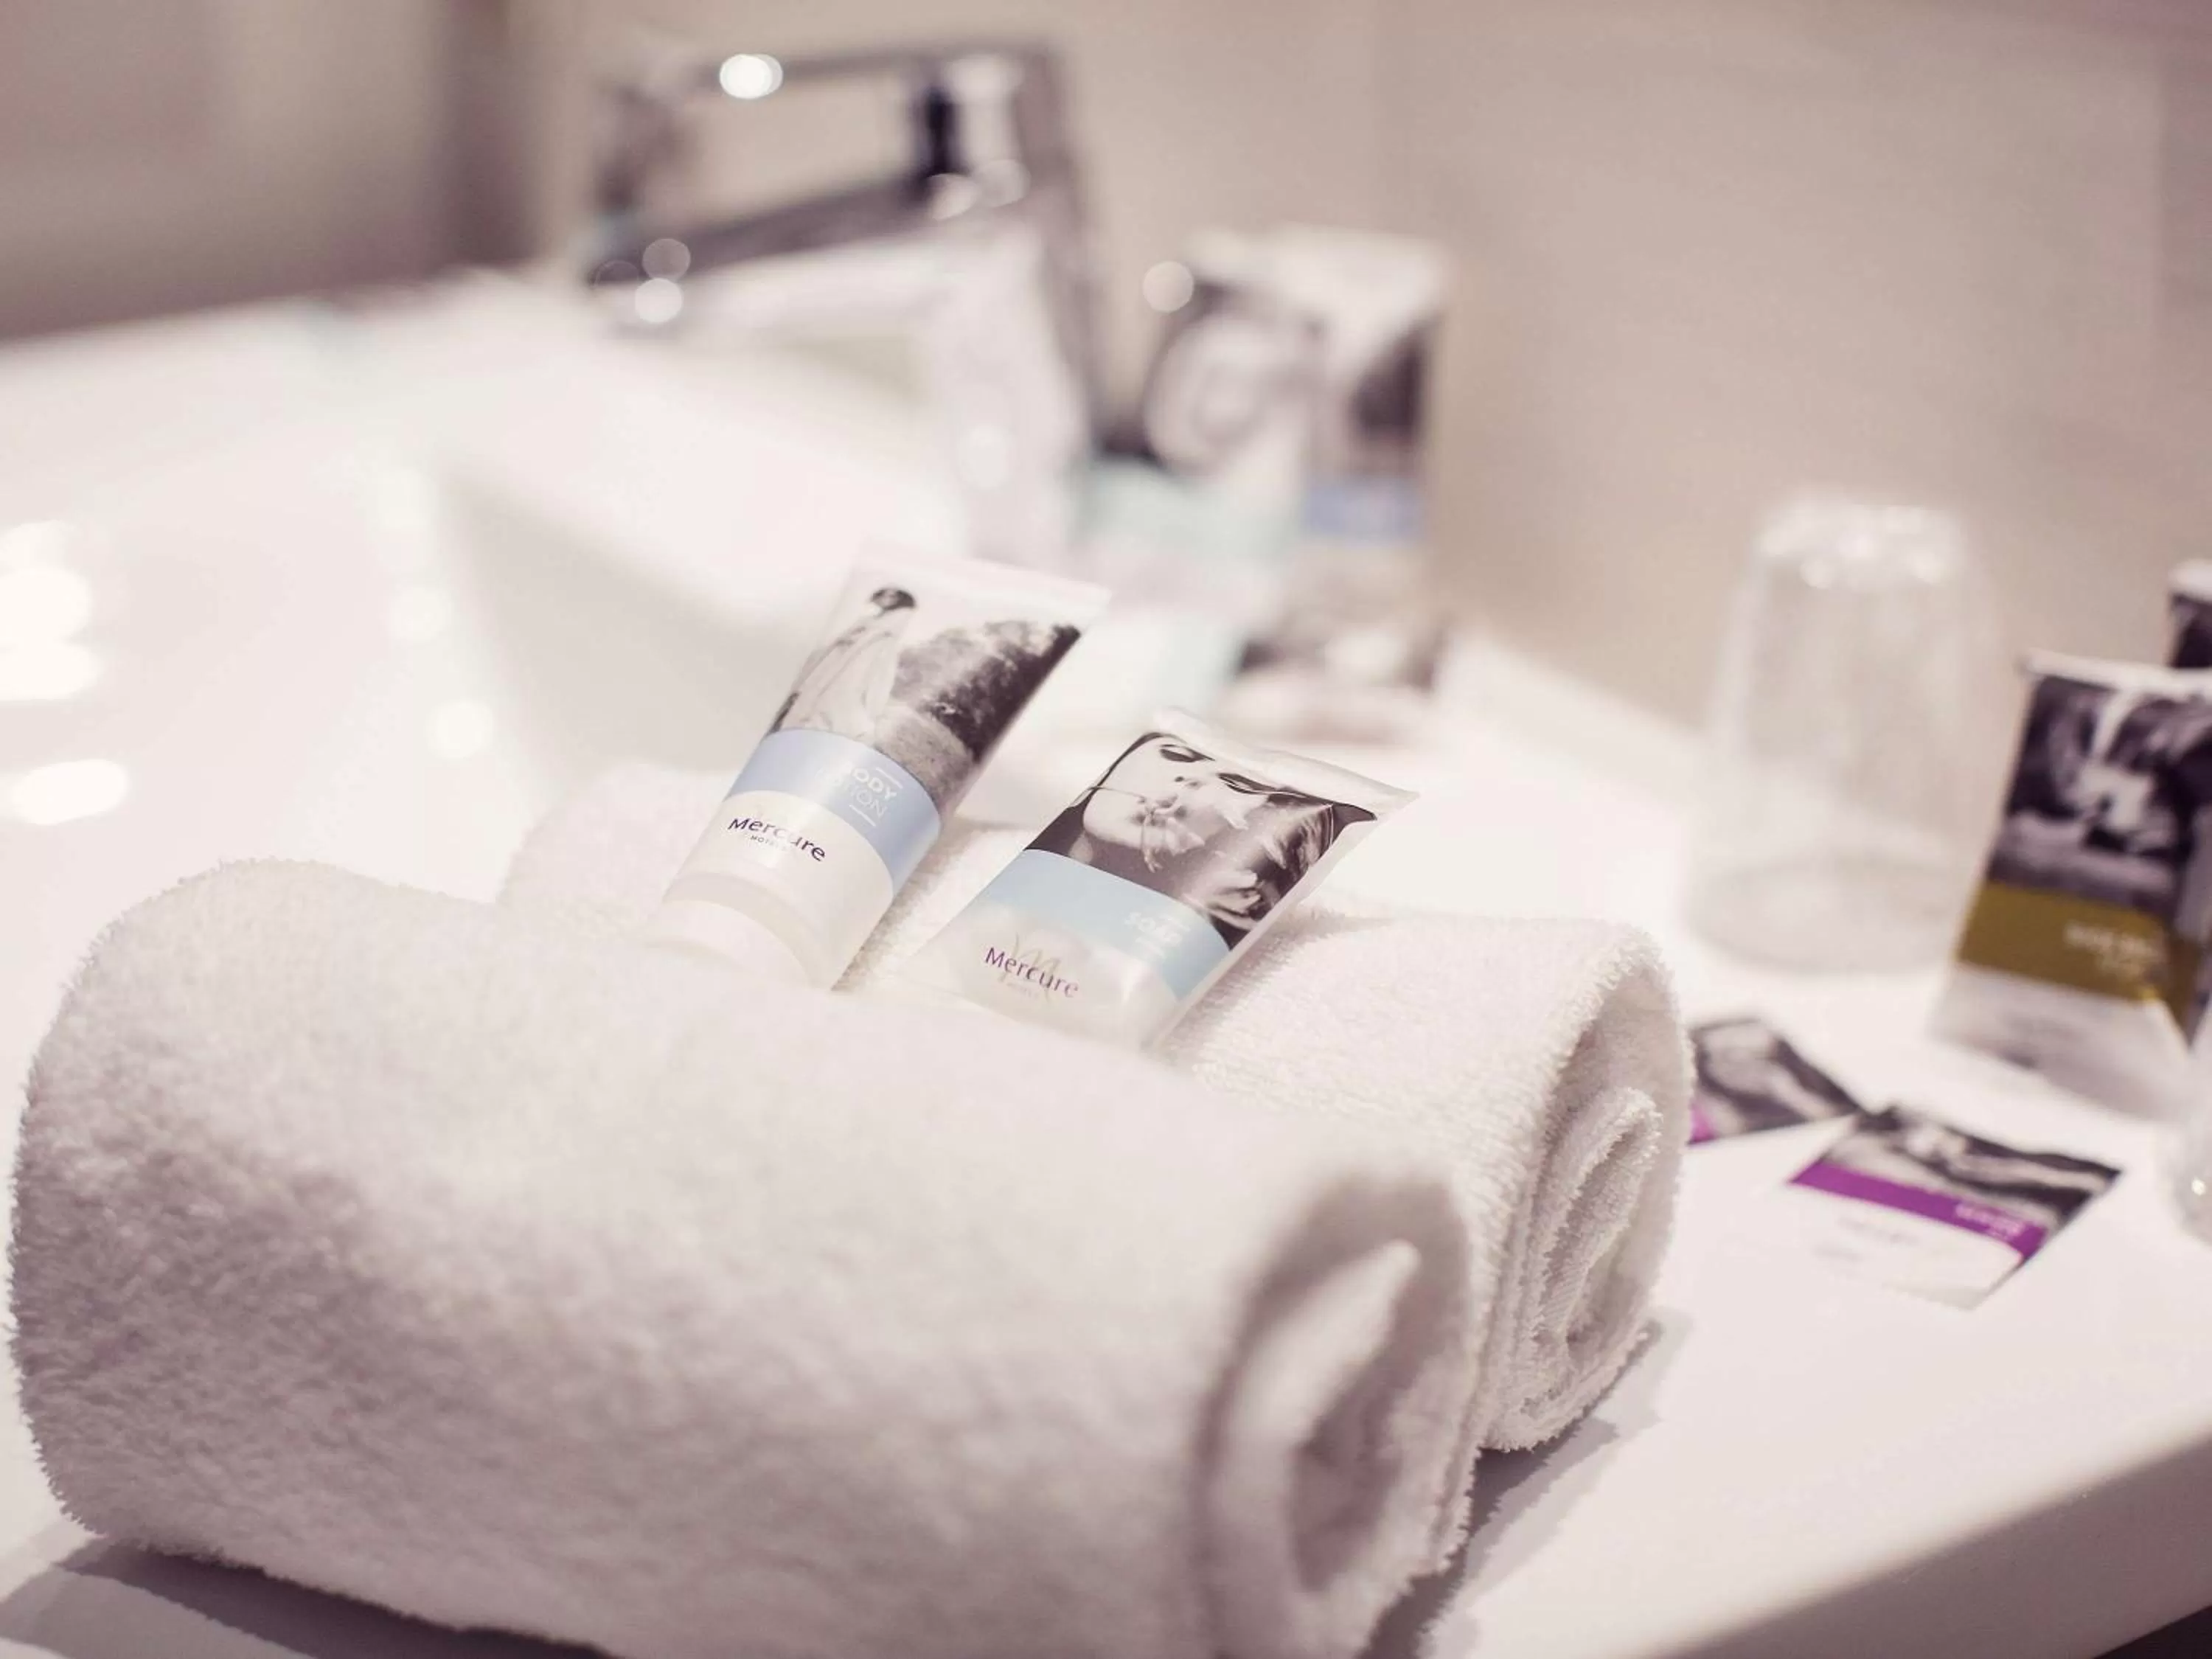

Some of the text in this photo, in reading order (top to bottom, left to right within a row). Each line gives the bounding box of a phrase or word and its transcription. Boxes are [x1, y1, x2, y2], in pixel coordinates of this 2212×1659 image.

[840, 759, 897, 801] ODY
[728, 817, 826, 862] Mercure
[984, 946, 1079, 998] Mercure
